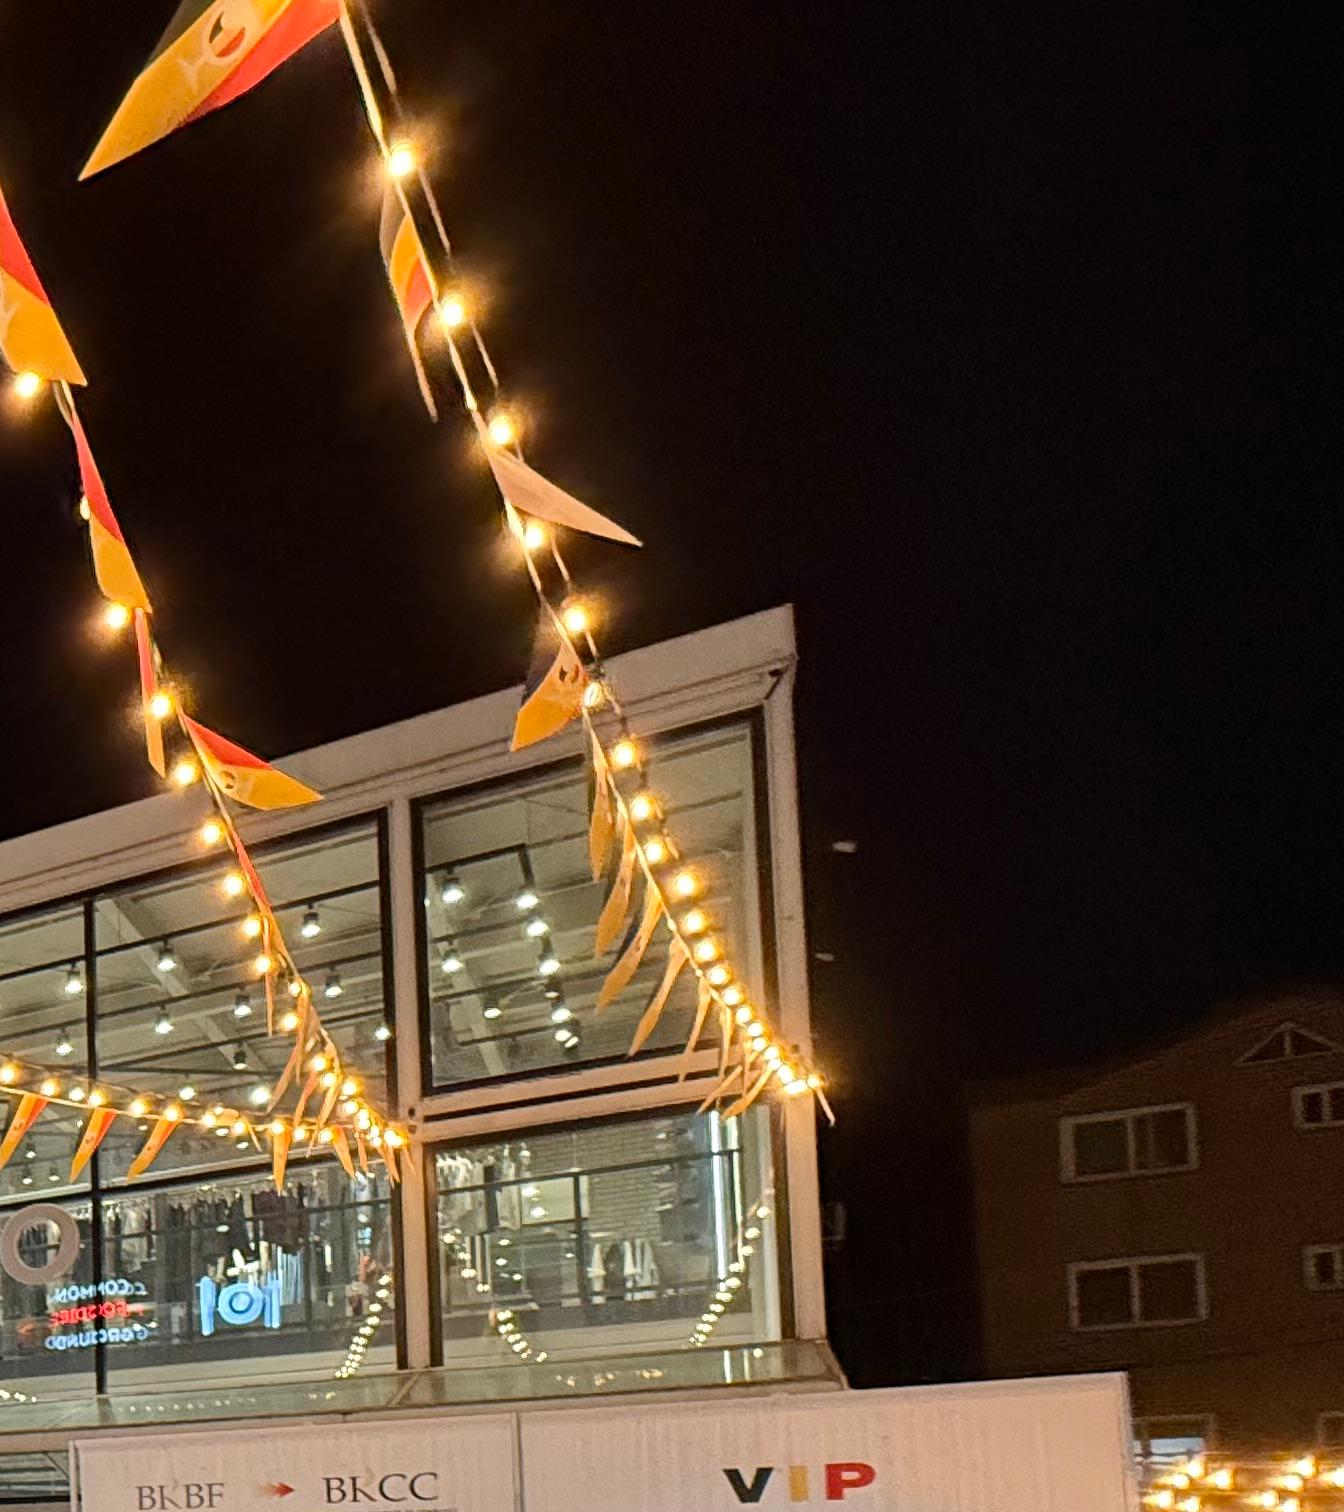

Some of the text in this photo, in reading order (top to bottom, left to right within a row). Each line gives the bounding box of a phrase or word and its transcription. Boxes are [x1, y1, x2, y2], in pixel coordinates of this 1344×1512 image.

[136, 1471, 439, 1511] BKBF BKCC
[722, 1461, 876, 1504] VIP
